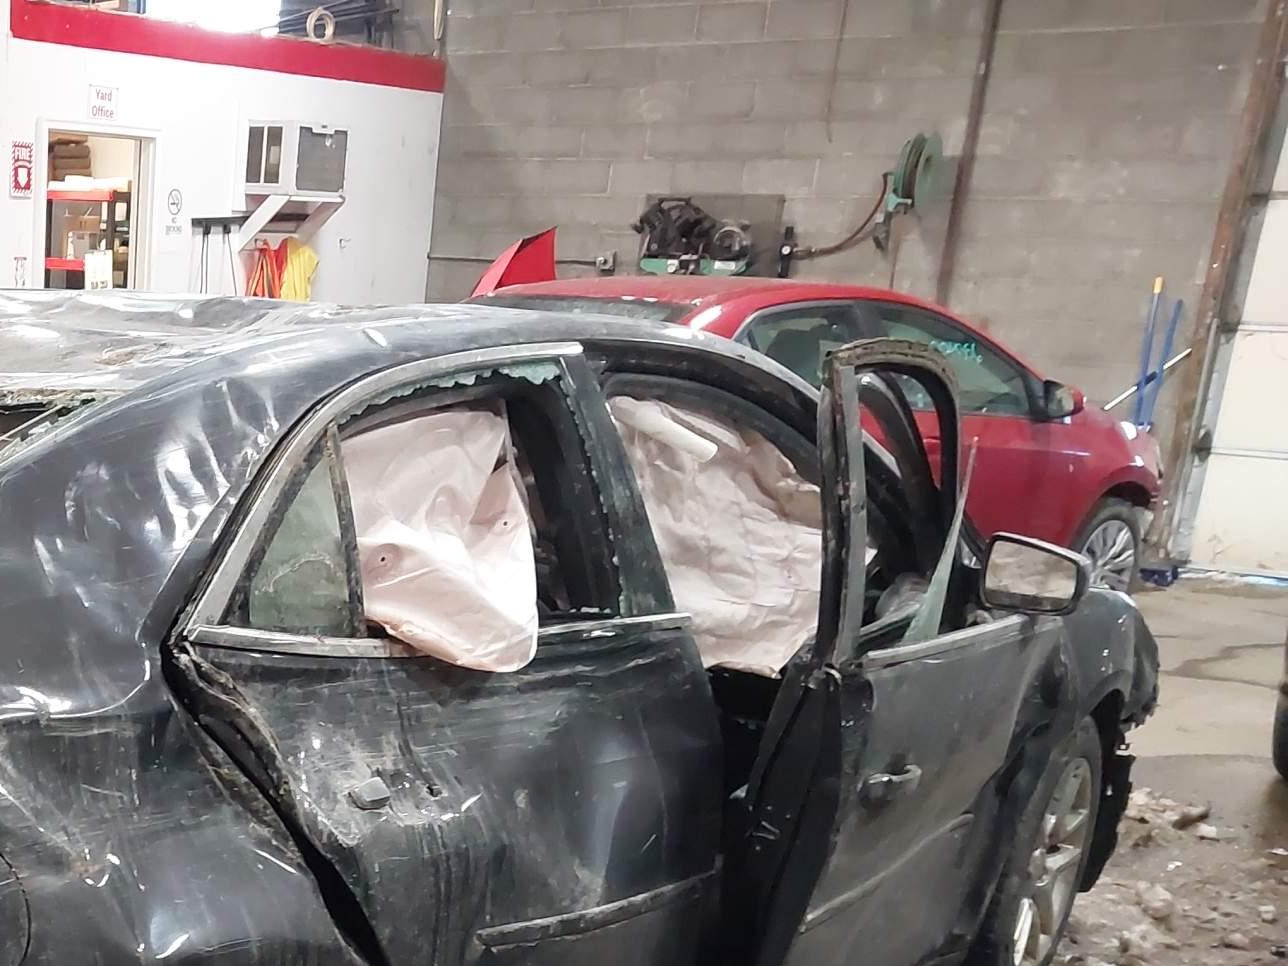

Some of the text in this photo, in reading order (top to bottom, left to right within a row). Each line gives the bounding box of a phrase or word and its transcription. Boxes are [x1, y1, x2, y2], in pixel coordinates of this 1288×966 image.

[95, 88, 113, 102] Yard
[91, 104, 115, 119] Office
[14, 147, 31, 161] FIRE
